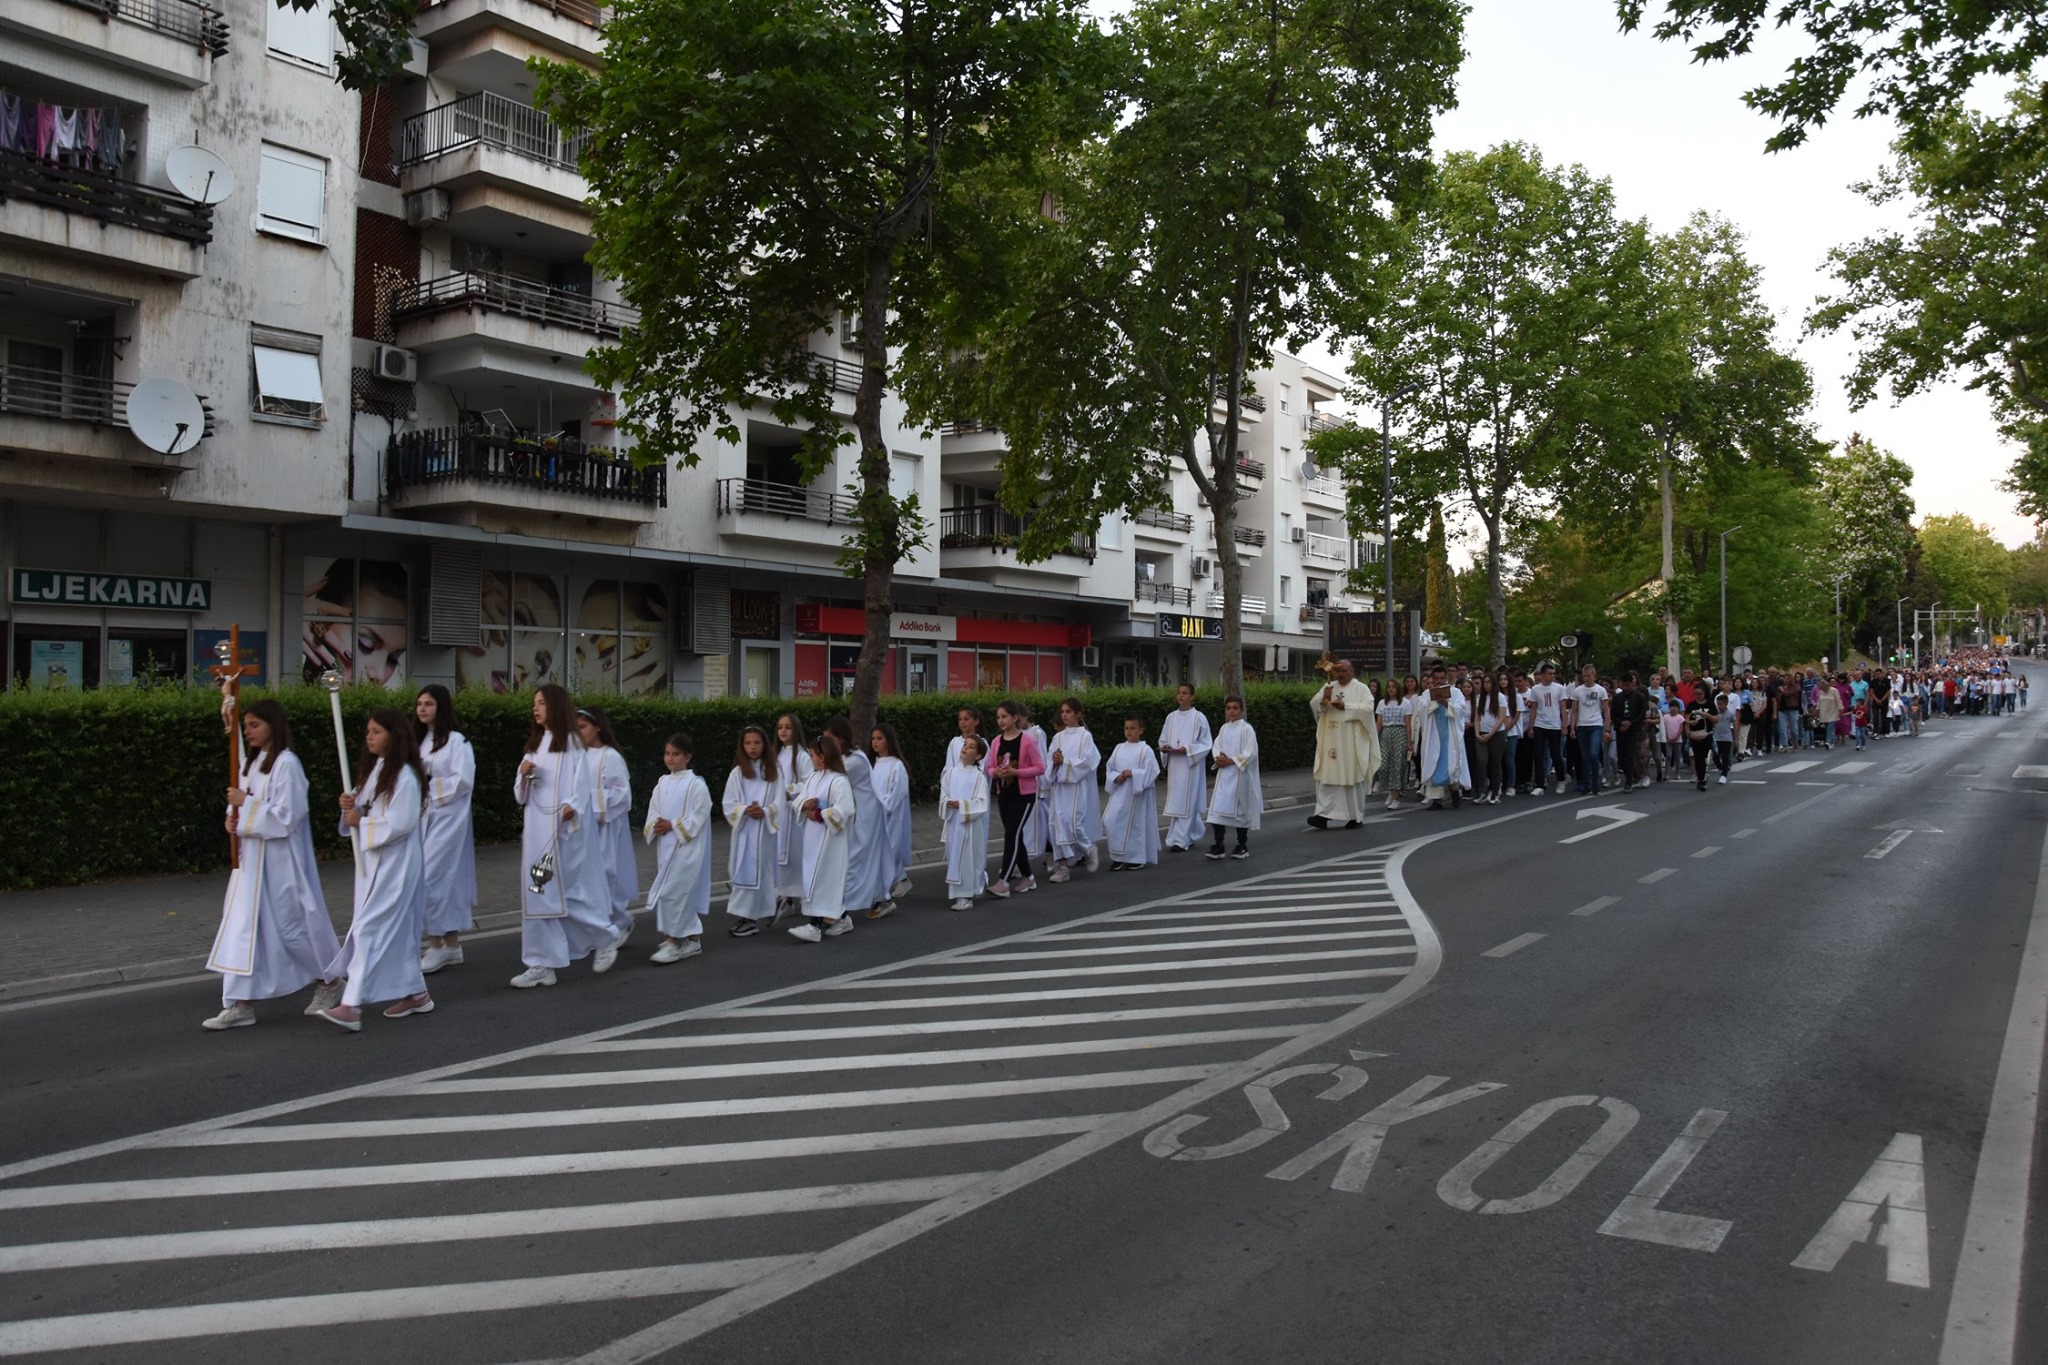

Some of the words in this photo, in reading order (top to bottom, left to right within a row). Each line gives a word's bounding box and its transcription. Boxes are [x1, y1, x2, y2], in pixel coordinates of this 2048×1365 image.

[20, 573, 206, 607] LJEKARNA
[899, 620, 923, 631] Addiko
[924, 622, 942, 632] Bank
[798, 679, 818, 688] Addiko
[798, 687, 813, 695] Bank
